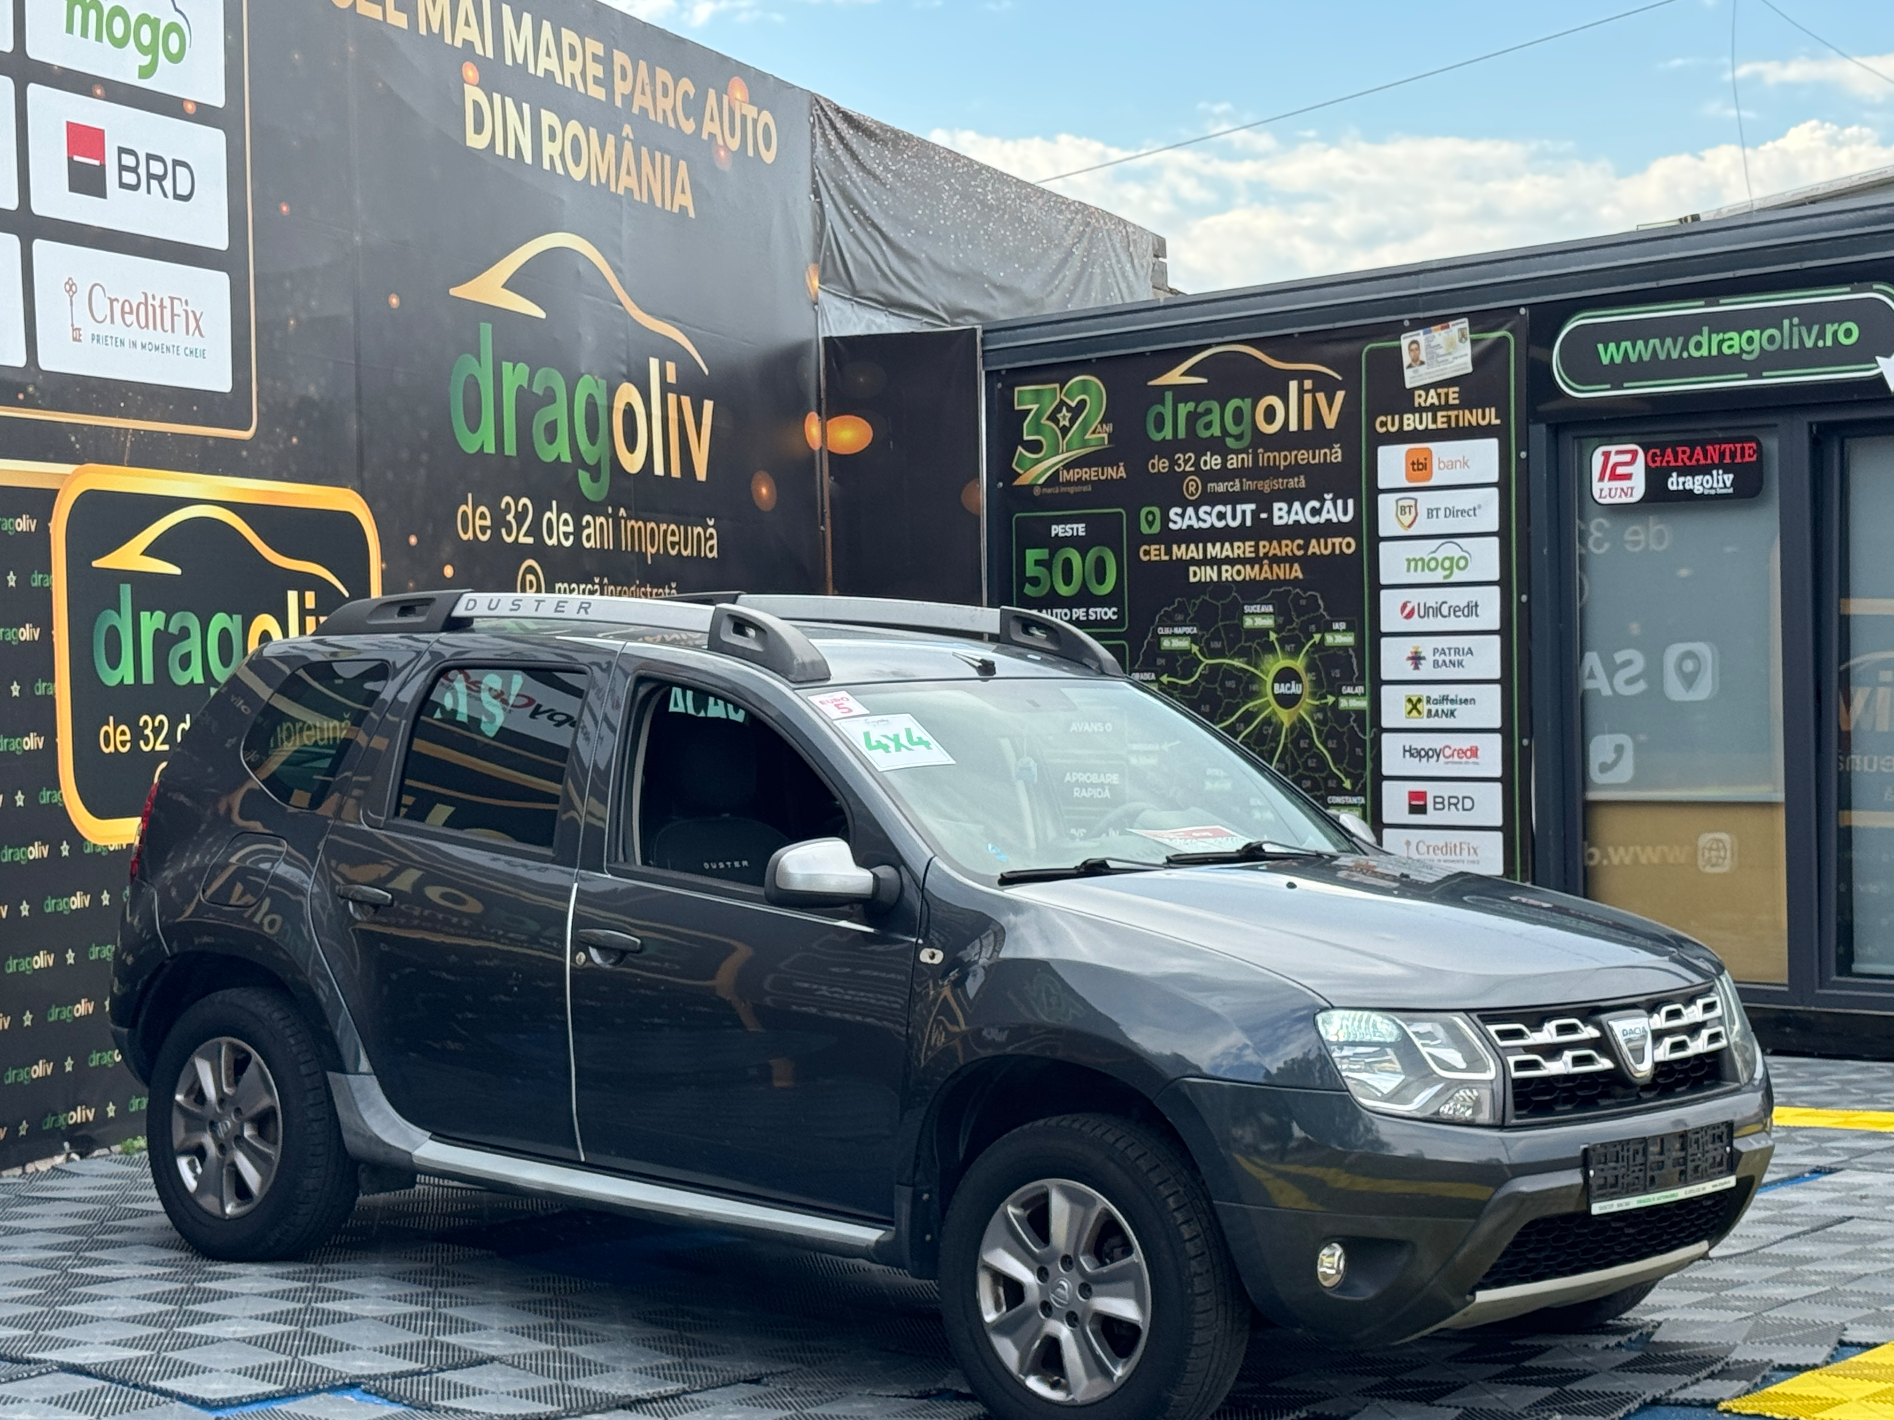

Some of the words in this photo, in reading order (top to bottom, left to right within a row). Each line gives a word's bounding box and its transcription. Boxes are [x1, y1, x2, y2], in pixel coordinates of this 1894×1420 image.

[65, 0, 187, 79] mogo
[502, 6, 606, 101] MARE
[613, 49, 696, 134] PARC
[701, 88, 777, 164] AUTO
[464, 82, 532, 164] DIN
[541, 108, 695, 218] ROMÂNIA
[117, 145, 196, 202] BRD
[87, 283, 206, 338] CreditFix
[91, 333, 125, 348] PRIETEN
[128, 340, 137, 350] IN
[141, 342, 181, 356] MOMENTE
[183, 347, 207, 359] CHEIE
[1597, 317, 1860, 365] www.dragoliv.ro
[1414, 387, 1460, 407] RATE
[449, 322, 714, 501] dragoliv
[1146, 380, 1346, 449] dragoliv
[1375, 414, 1399, 433] CU
[1402, 407, 1500, 431] BULETINUL
[1011, 374, 1107, 475] 32
[1148, 455, 1169, 473] de
[1174, 453, 1195, 472] 32
[1200, 451, 1222, 470] de
[1226, 449, 1252, 468] ani
[1258, 443, 1342, 470] împreună
[1410, 457, 1428, 472] tbi
[1437, 456, 1470, 471] bank
[1597, 450, 1639, 482] 12
[1647, 442, 1758, 468] GARANTIE
[1059, 461, 1127, 483] ÎMPREUNĂ
[1667, 469, 1734, 494] dragoliv
[1207, 479, 1240, 493] marcă
[1242, 475, 1306, 493] înregistrată
[1598, 486, 1635, 500] LUNI
[1168, 503, 1256, 530] SASCUT
[1272, 493, 1354, 526] BACĂU
[1400, 504, 1414, 516] BT
[1426, 507, 1441, 520] BT
[457, 493, 492, 542] de
[500, 495, 534, 544] 32
[542, 500, 574, 548] de
[582, 506, 613, 550] ani
[619, 508, 718, 564] împreună
[1051, 523, 1086, 537] PESTE
[1139, 545, 1169, 561] CEL
[1172, 543, 1203, 560] MAI
[1206, 541, 1255, 559] MARE
[1258, 539, 1303, 556] PARC
[1307, 537, 1356, 555] AUTO
[1023, 545, 1117, 597] 500
[1189, 566, 1218, 582] DIN
[1221, 559, 1303, 581] ROMÂNIA
[1405, 554, 1469, 580] mogo
[464, 598, 593, 615] DUSTER
[1072, 608, 1087, 621] PE
[1088, 607, 1118, 620] STOC
[1243, 605, 1274, 613] SUCEAVA
[1417, 600, 1479, 619] UniCredit
[1432, 647, 1474, 657] PATRIA
[1432, 659, 1465, 669] BANK
[1273, 681, 1302, 694] BACĂU
[834, 703, 853, 714] 5
[1425, 694, 1476, 706] Raiffeisen
[1426, 708, 1457, 719] BANK
[99, 716, 131, 753] de
[138, 714, 170, 752] 32
[1070, 722, 1104, 732] AVANS
[1402, 744, 1480, 763] HappyCredit
[1064, 772, 1120, 785] APROBARE
[1073, 786, 1111, 799] RAPIDĂ
[1432, 795, 1475, 811] BRD
[0, 841, 49, 864] dragoliv
[1415, 840, 1479, 857] CreditFix
[43, 891, 91, 914] dragoliv
[5, 950, 54, 974] dragoliv
[47, 998, 95, 1023] dragoliv
[1621, 1026, 1648, 1037] DACIA
[4, 1059, 54, 1084] dragoliv
[42, 1105, 96, 1130] dragoliv
